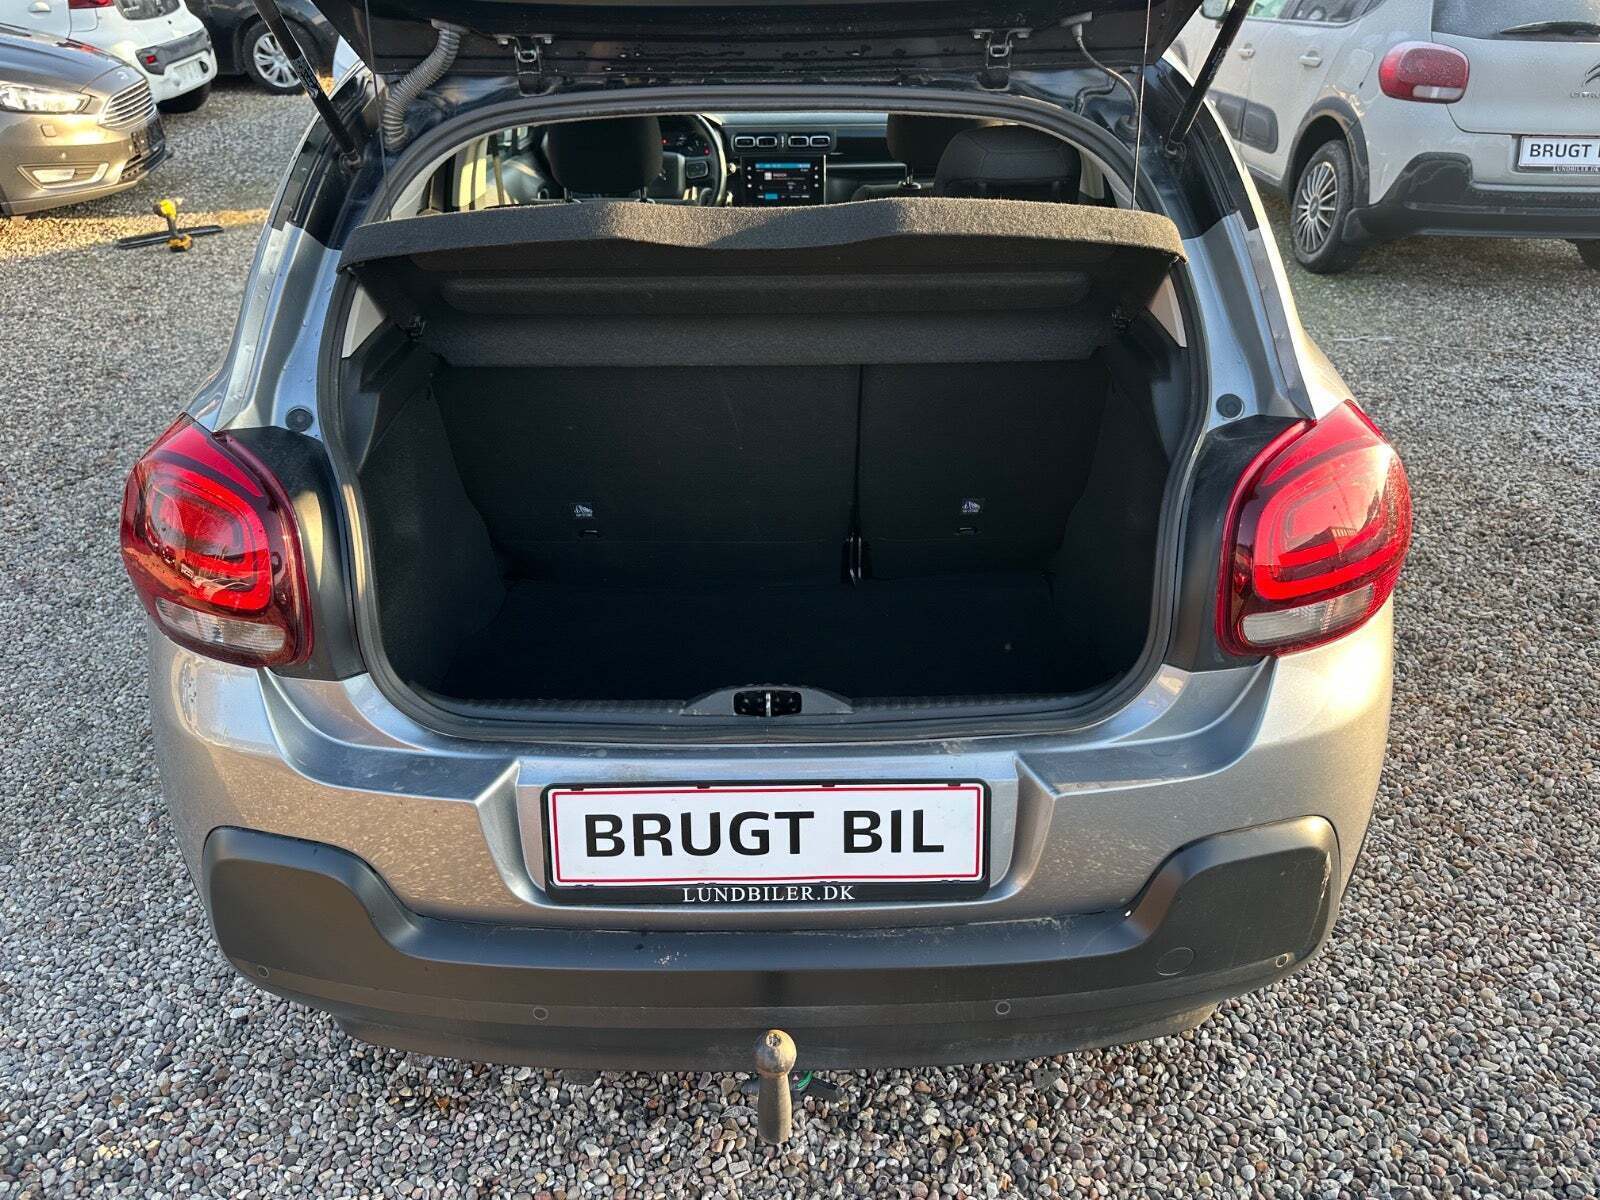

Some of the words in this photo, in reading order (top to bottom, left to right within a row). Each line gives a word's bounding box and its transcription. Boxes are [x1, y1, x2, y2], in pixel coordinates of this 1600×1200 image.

[1529, 143, 1592, 158] BRUGT
[584, 811, 815, 857] BRUGT
[843, 809, 945, 854] BIL
[682, 885, 856, 902] LUNDBILER.DK
